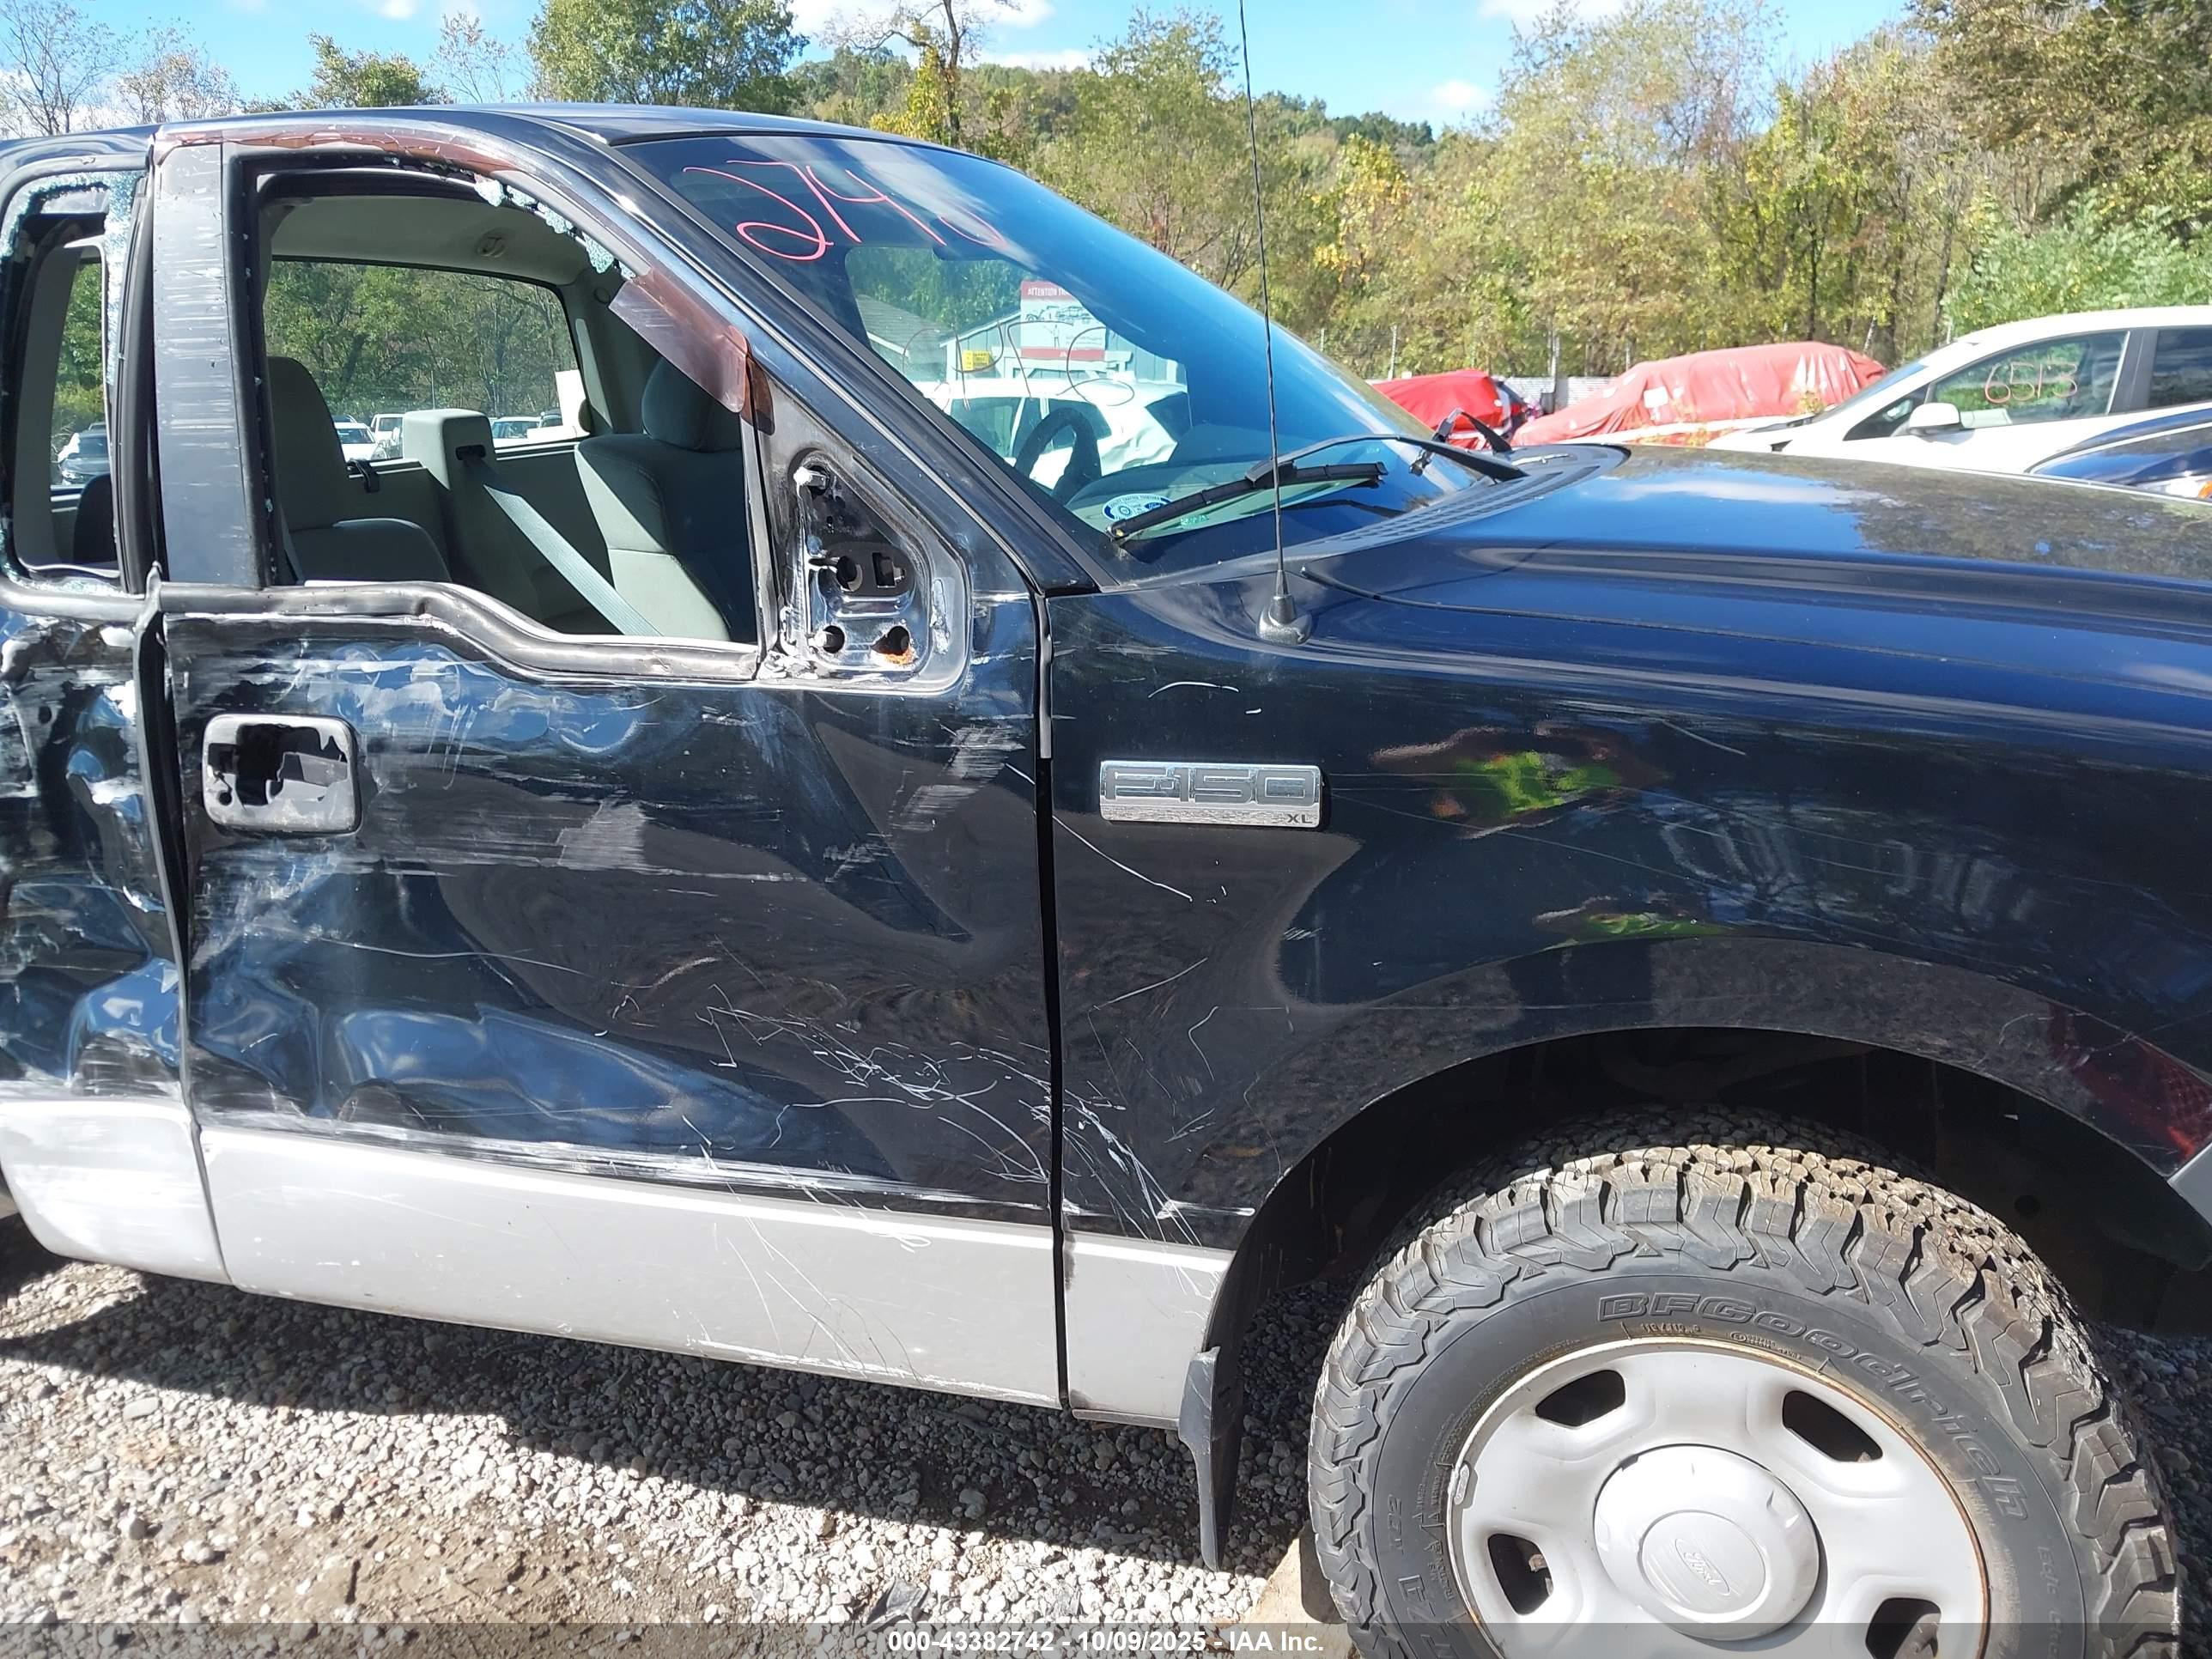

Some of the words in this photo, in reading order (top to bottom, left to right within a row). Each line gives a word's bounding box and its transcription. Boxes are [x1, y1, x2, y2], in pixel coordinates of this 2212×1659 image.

[1984, 362, 2079, 405] 6513
[1286, 813, 1313, 824] XL
[1597, 1291, 2028, 1520] BFGoodrich
